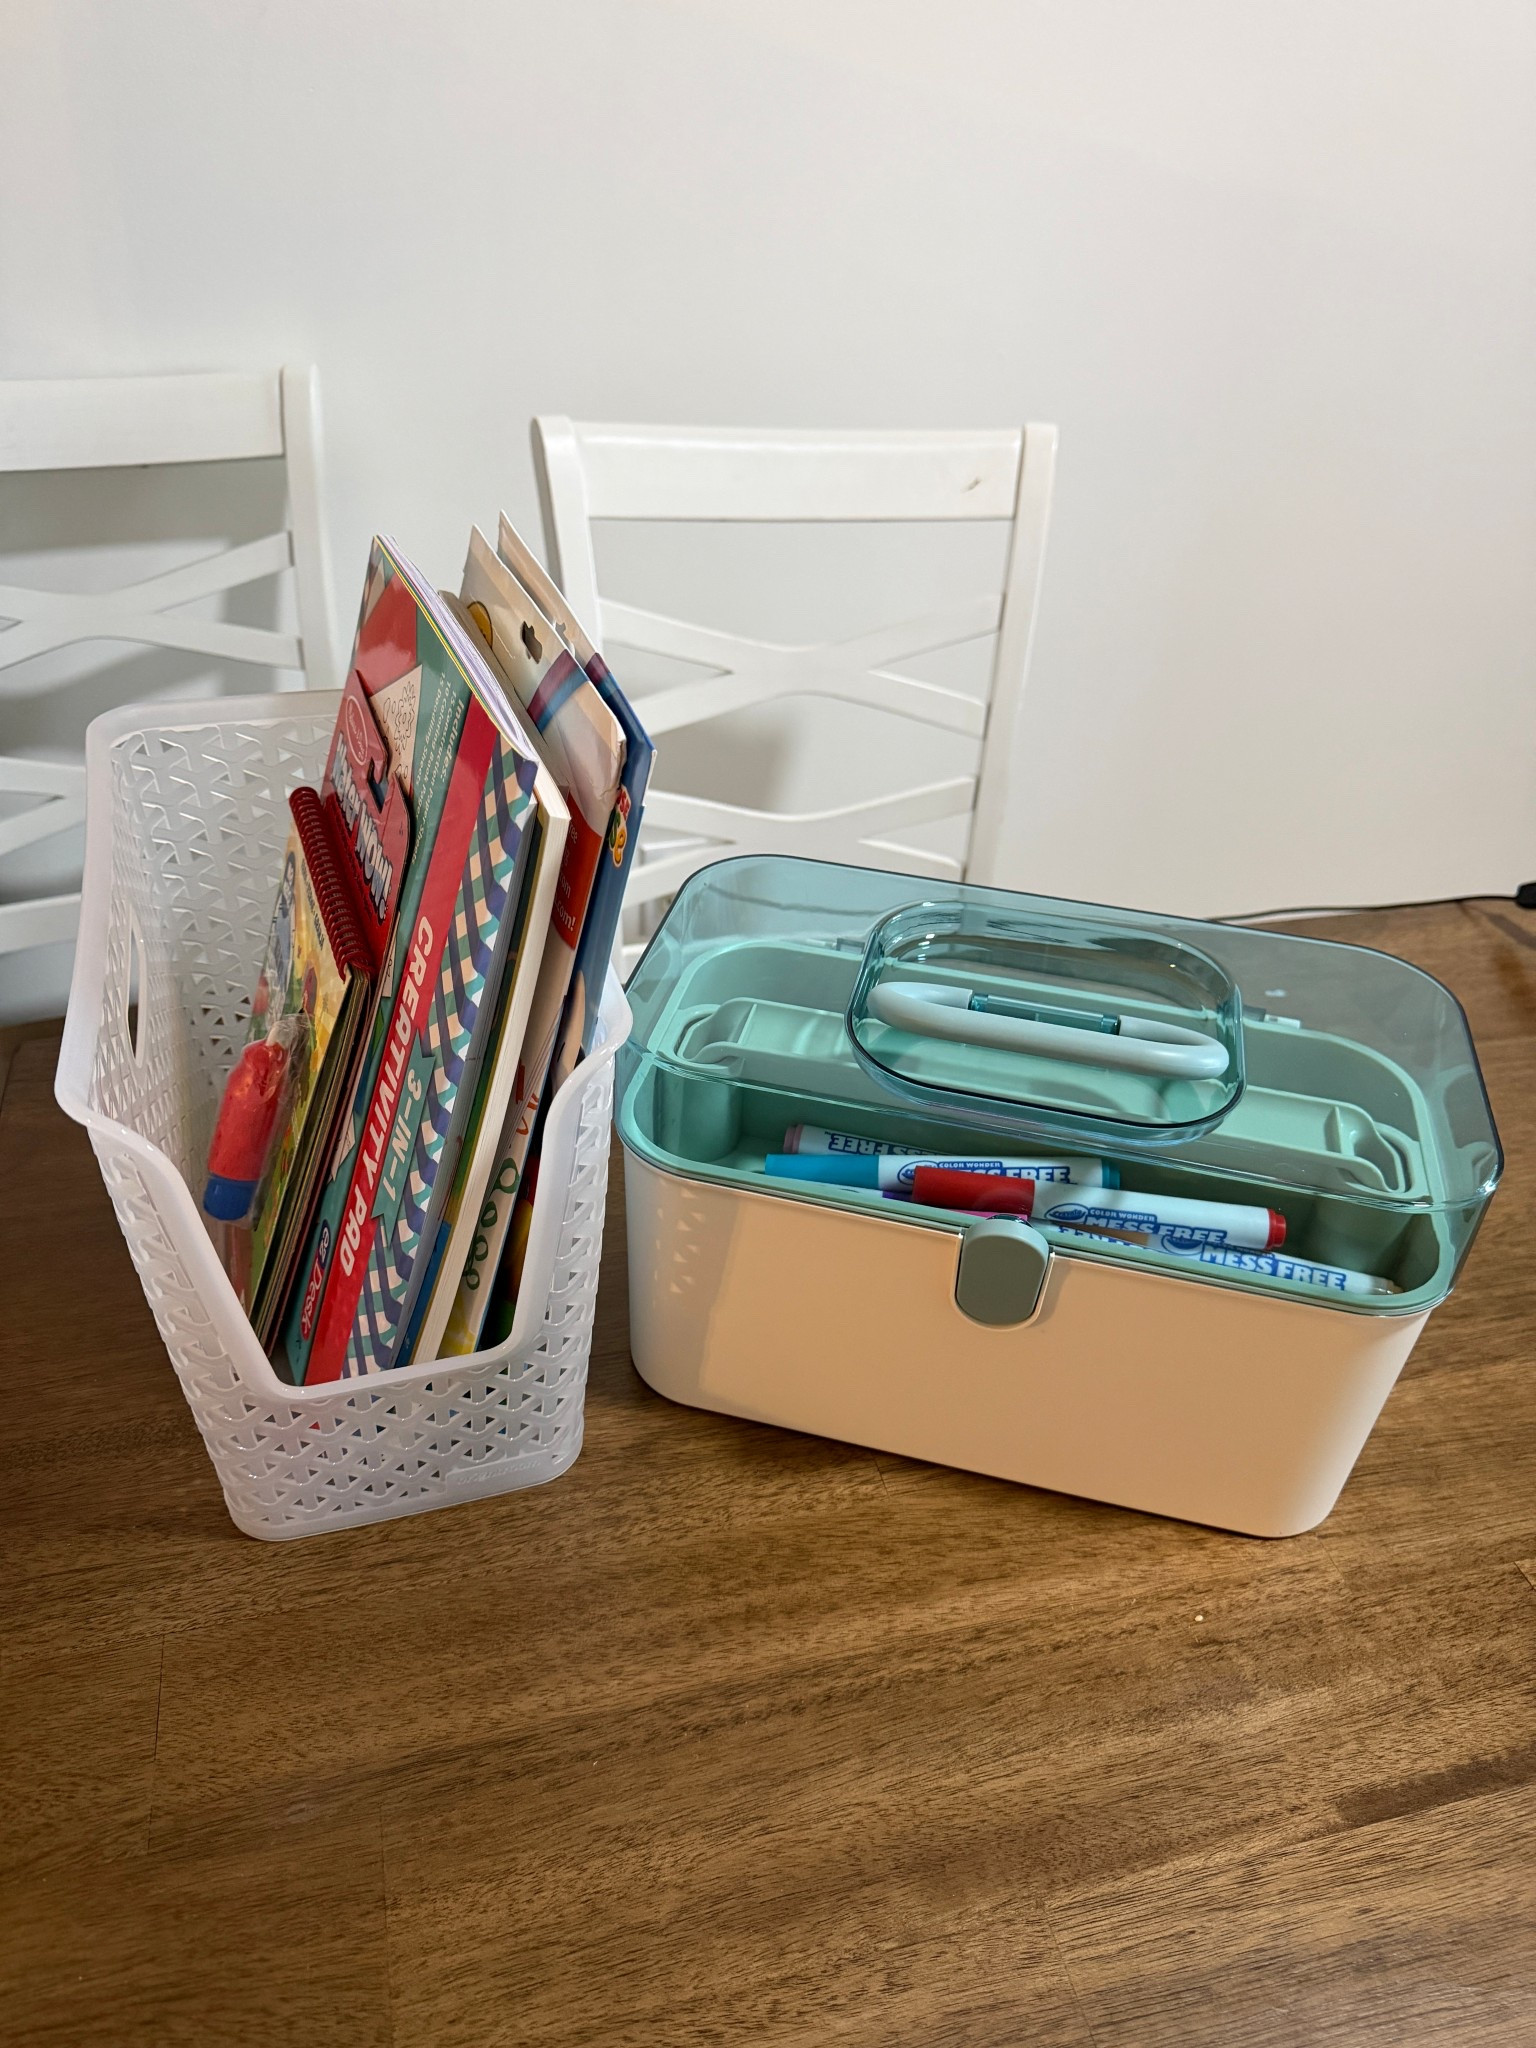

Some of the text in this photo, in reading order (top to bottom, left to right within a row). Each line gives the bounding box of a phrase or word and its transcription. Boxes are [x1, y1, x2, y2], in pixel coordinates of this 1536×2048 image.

[425, 687, 442, 745] Doodling
[431, 698, 447, 750] Coloring
[431, 707, 453, 786] Construction
[441, 699, 465, 783] Includes:
[415, 744, 428, 785] Sheets
[423, 750, 434, 783] Book
[414, 784, 426, 820] Pages
[423, 786, 433, 823] Paper
[411, 823, 424, 866] Sheets
[568, 824, 578, 845] ree
[560, 873, 572, 898] rom
[340, 915, 434, 1277] CREATIVITY PAD
[384, 1069, 422, 1201] 3-IN-1
[830, 1135, 889, 1155] FREE
[1006, 1168, 1069, 1183] FREE
[1087, 1216, 1153, 1234] MESS
[1159, 1226, 1224, 1244] FREE
[1090, 1208, 1155, 1221] COLOR WONDER
[1202, 1245, 1274, 1276] MESS
[1277, 1261, 1345, 1290] FREE
